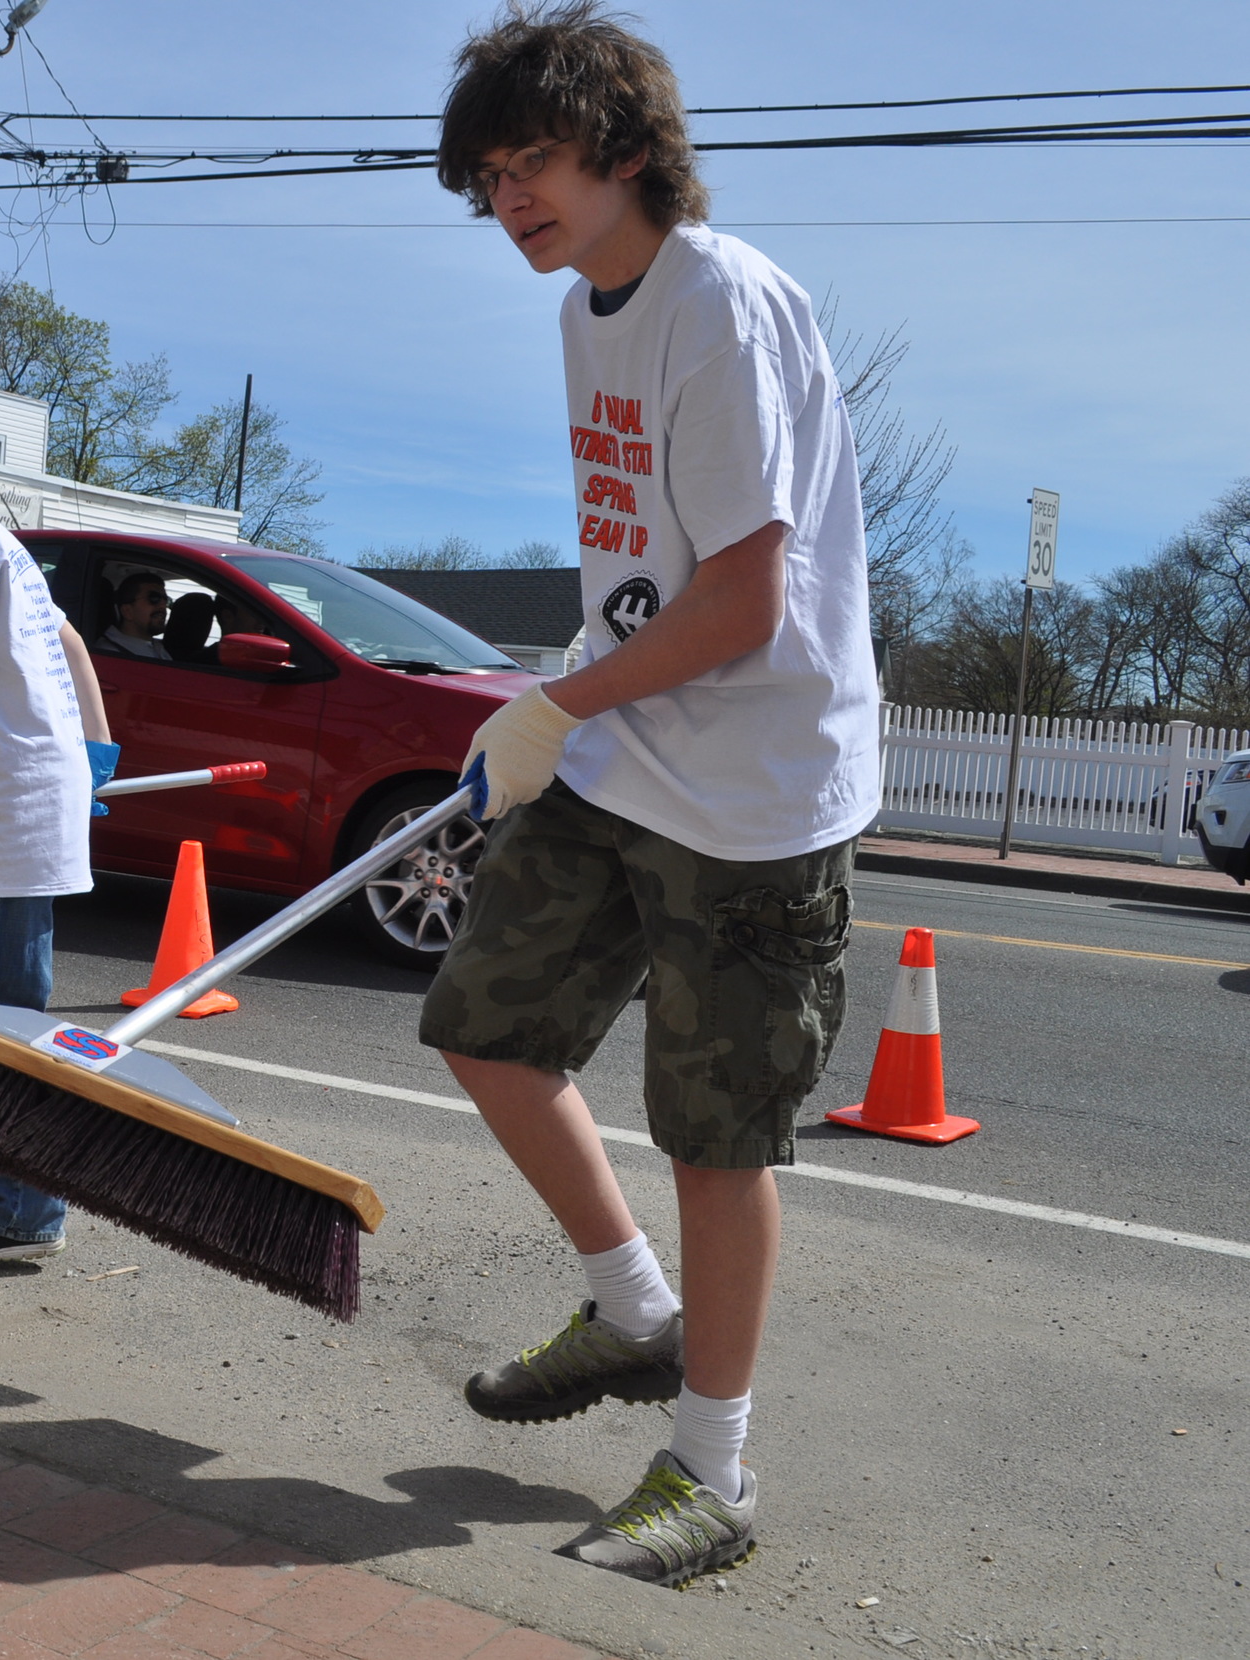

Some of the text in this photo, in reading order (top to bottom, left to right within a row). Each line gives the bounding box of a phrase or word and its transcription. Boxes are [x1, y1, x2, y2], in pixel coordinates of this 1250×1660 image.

[1034, 500, 1057, 519] SPEED
[629, 524, 648, 558] UP
[1035, 521, 1052, 538] LIMIT
[1031, 539, 1052, 577] 30
